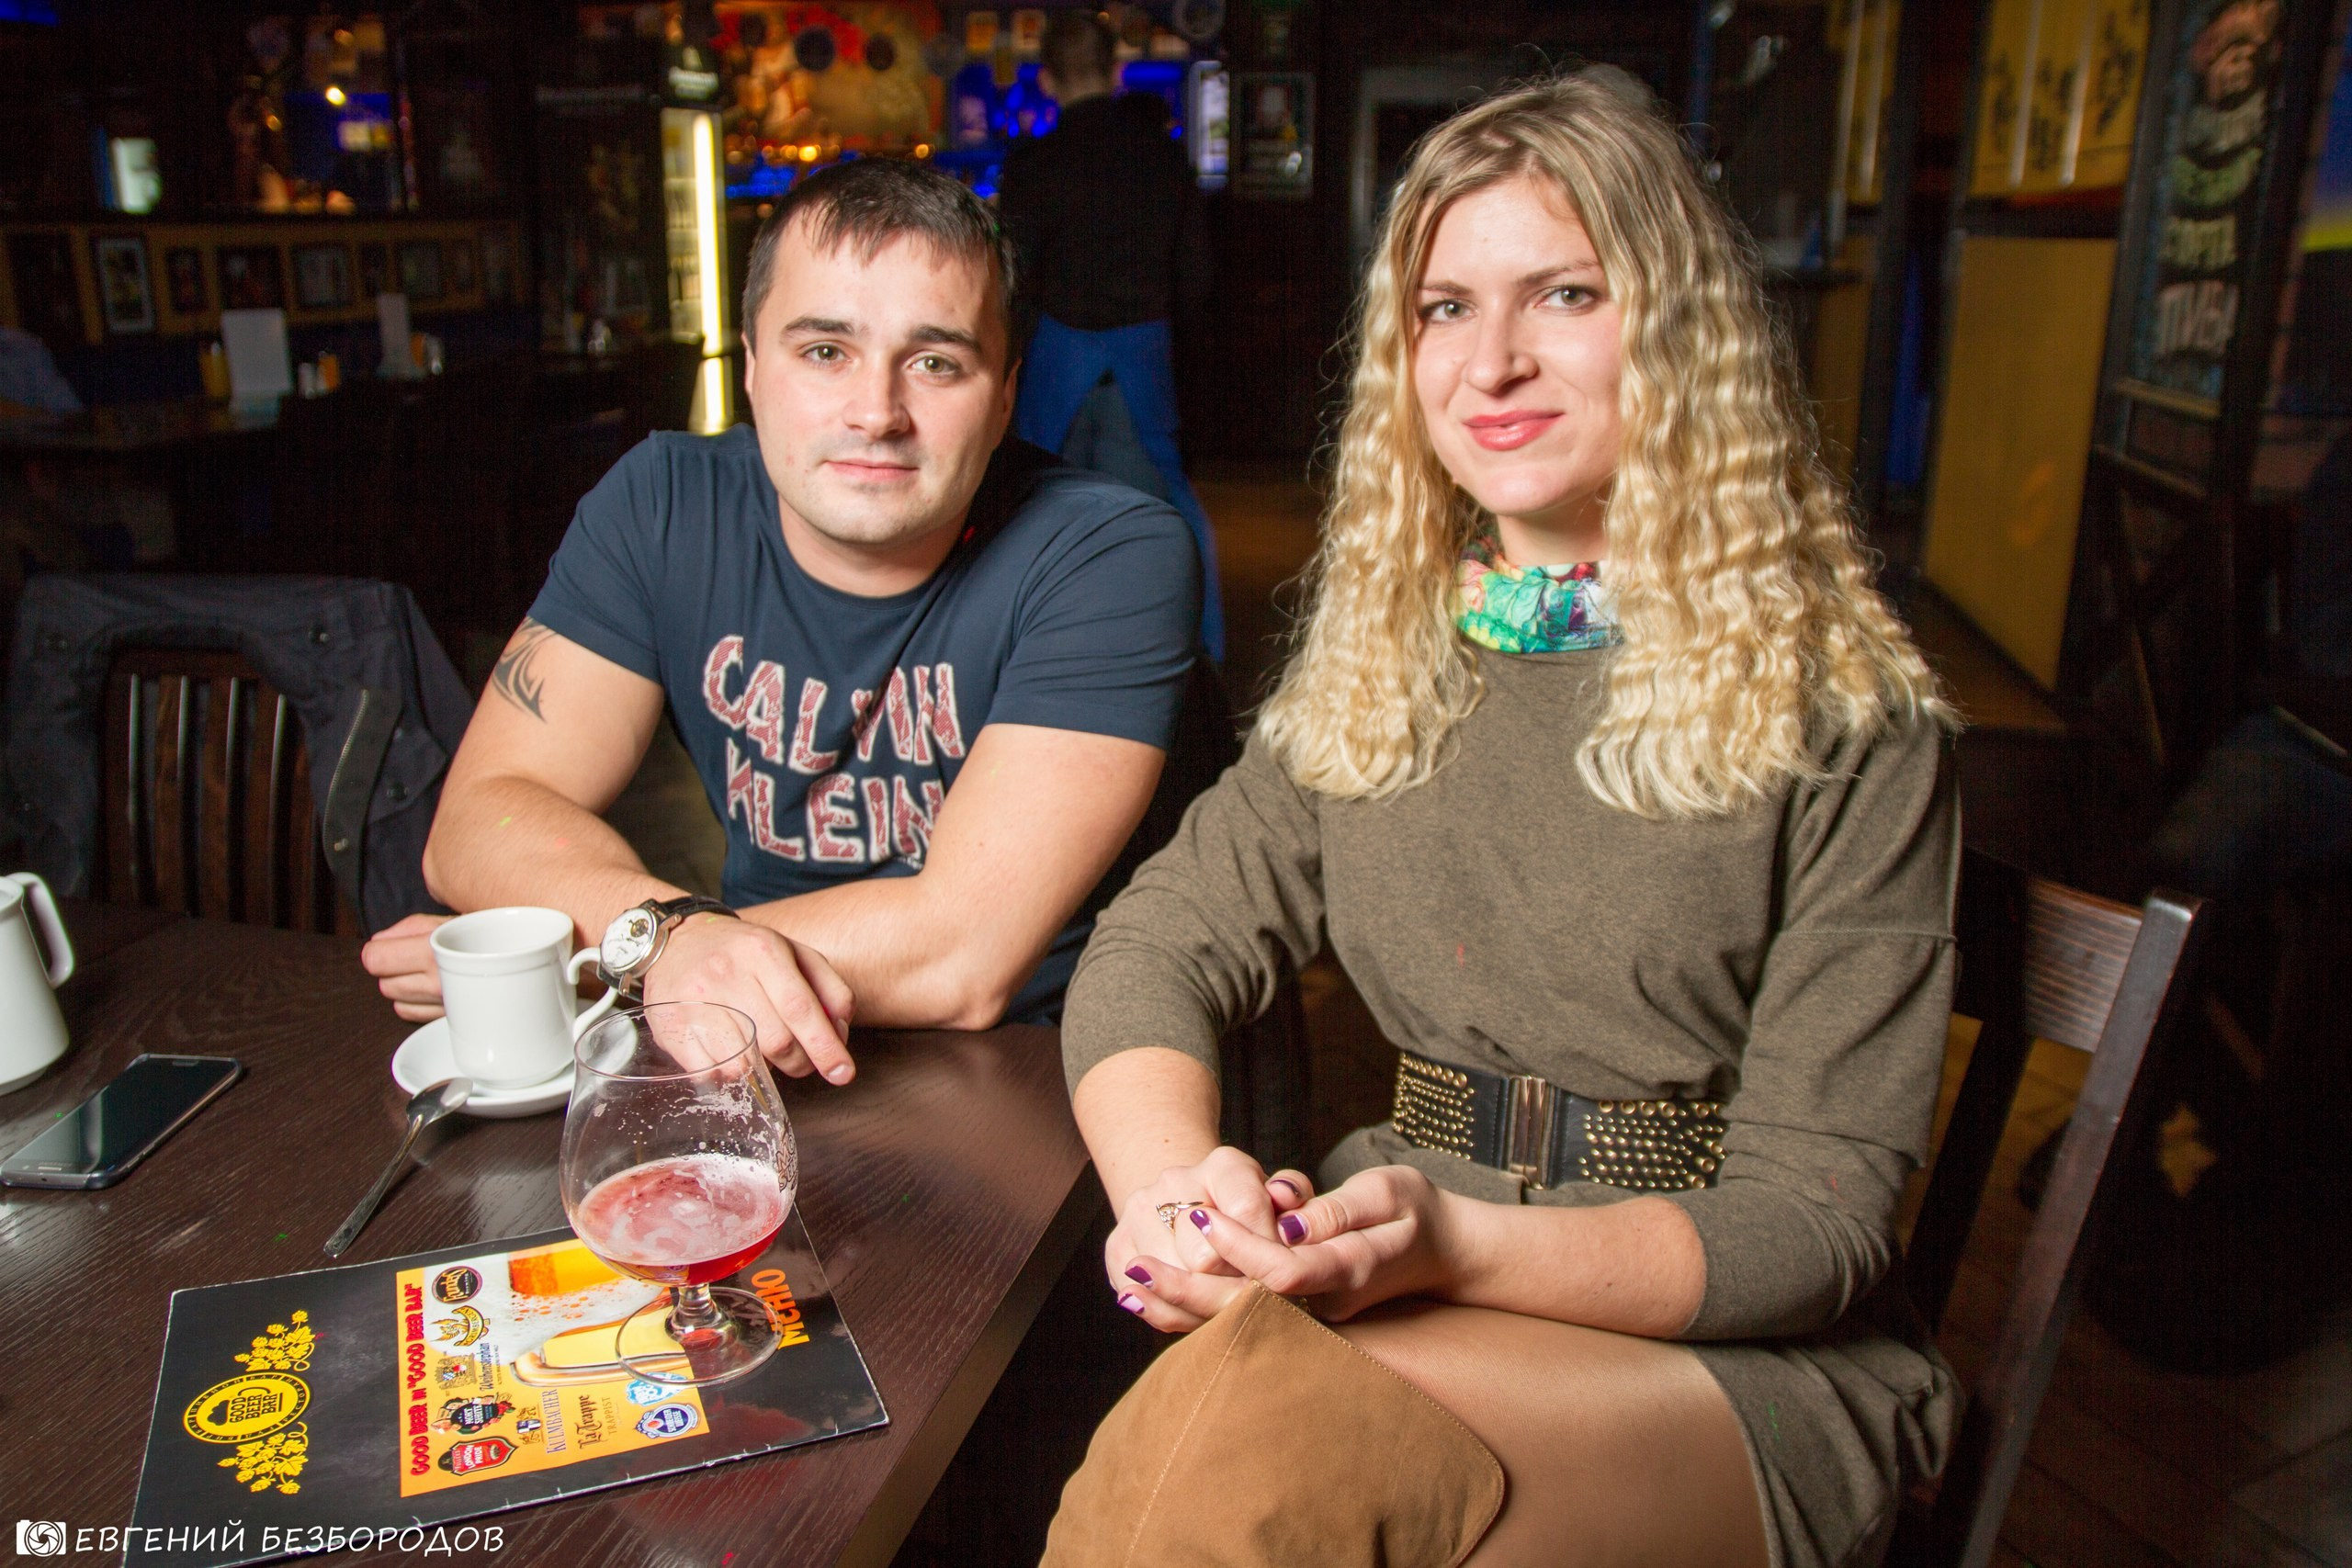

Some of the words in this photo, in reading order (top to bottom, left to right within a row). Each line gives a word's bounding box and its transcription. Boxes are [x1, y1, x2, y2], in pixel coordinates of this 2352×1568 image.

[702, 634, 966, 774] CALVIN
[726, 737, 946, 863] KLEIN
[440, 1269, 469, 1303] Founders
[406, 1311, 425, 1342] BEER
[229, 1397, 247, 1423] GOOD
[244, 1394, 262, 1419] BEER
[260, 1393, 277, 1415] BAR
[408, 1404, 429, 1434] BEER
[602, 1396, 617, 1435] TRAPPIST
[540, 1388, 567, 1454] KULMBACHER
[409, 1437, 430, 1476] GOOD
[462, 1445, 476, 1470] LONDON
[473, 1446, 484, 1465] PRIDE
